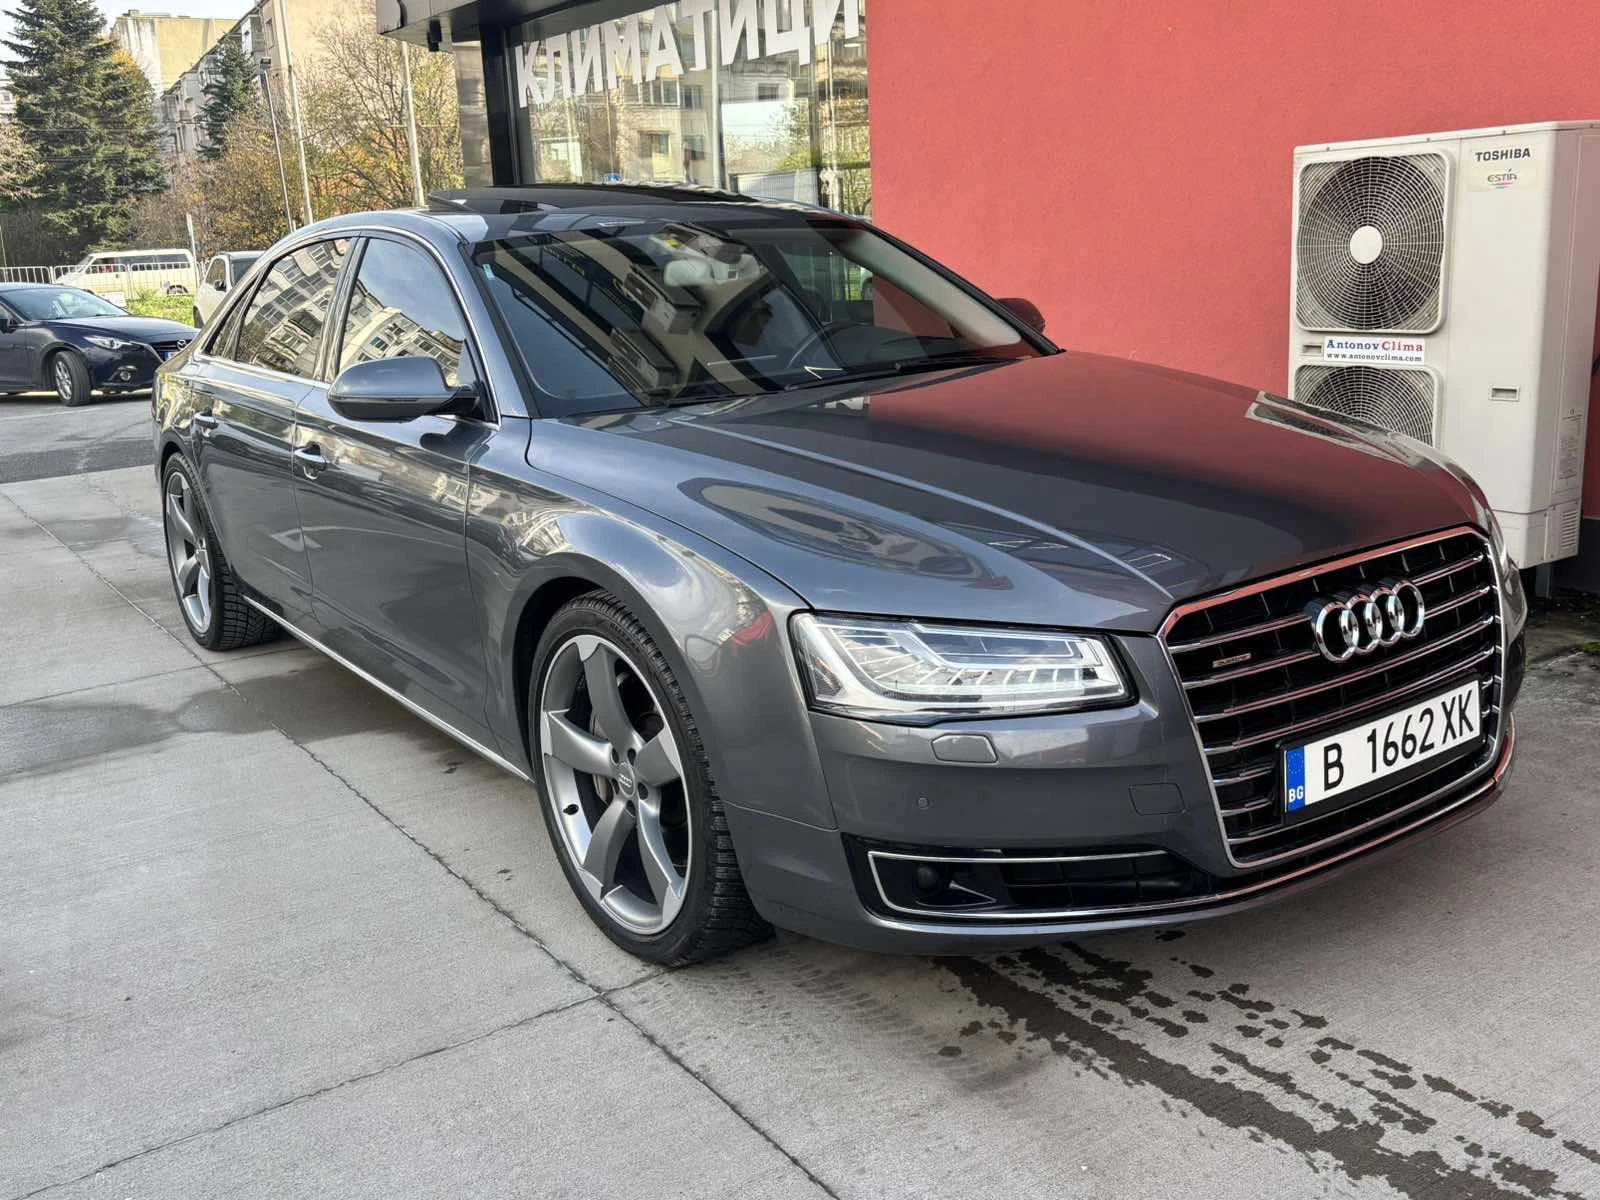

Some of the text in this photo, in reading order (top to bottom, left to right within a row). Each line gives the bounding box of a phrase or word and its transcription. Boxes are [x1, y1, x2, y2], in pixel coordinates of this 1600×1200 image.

[515, 0, 860, 109] КЛИМАТИЦИ
[1475, 148, 1531, 162] TOSHIBA
[1323, 742, 1345, 792] B
[1288, 785, 1305, 804] BG
